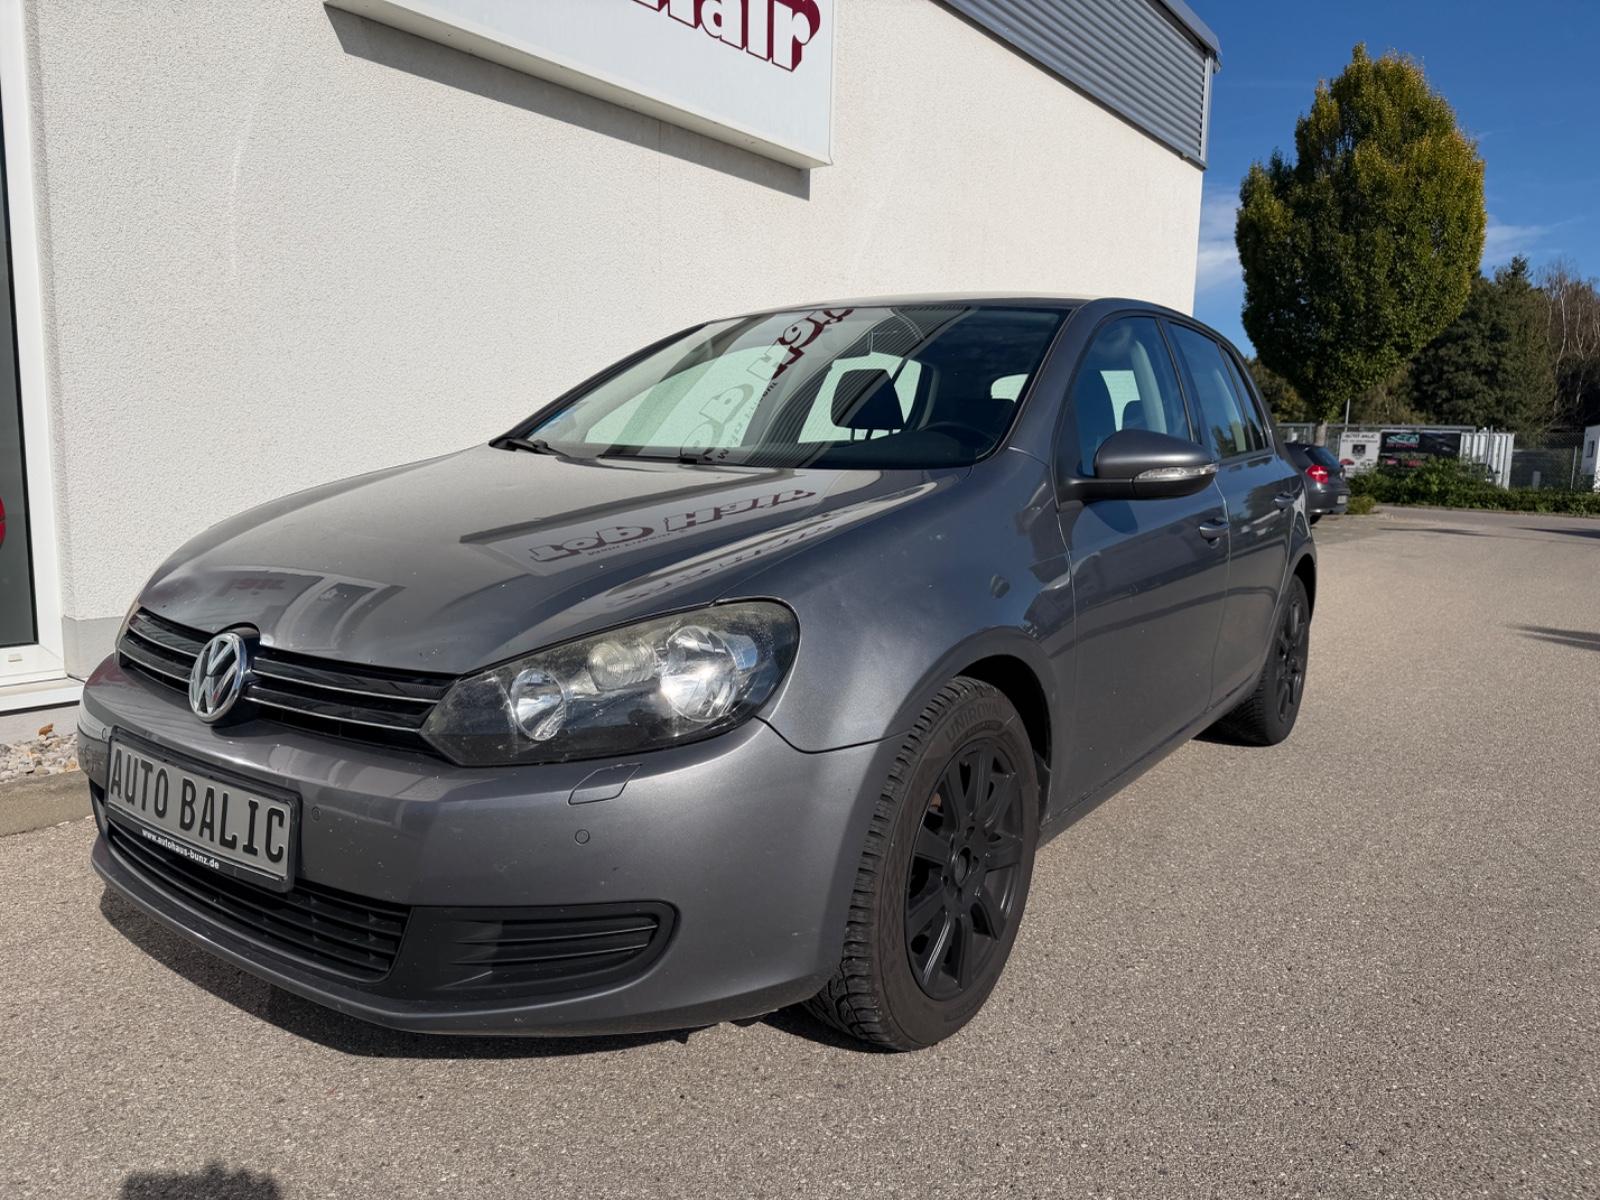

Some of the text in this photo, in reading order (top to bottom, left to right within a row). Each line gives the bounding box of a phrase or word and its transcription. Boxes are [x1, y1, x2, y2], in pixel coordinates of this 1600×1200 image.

[632, 0, 820, 72] air
[110, 748, 285, 863] AUTO BALIC
[141, 828, 220, 870] www.autohaus-bunz.de
